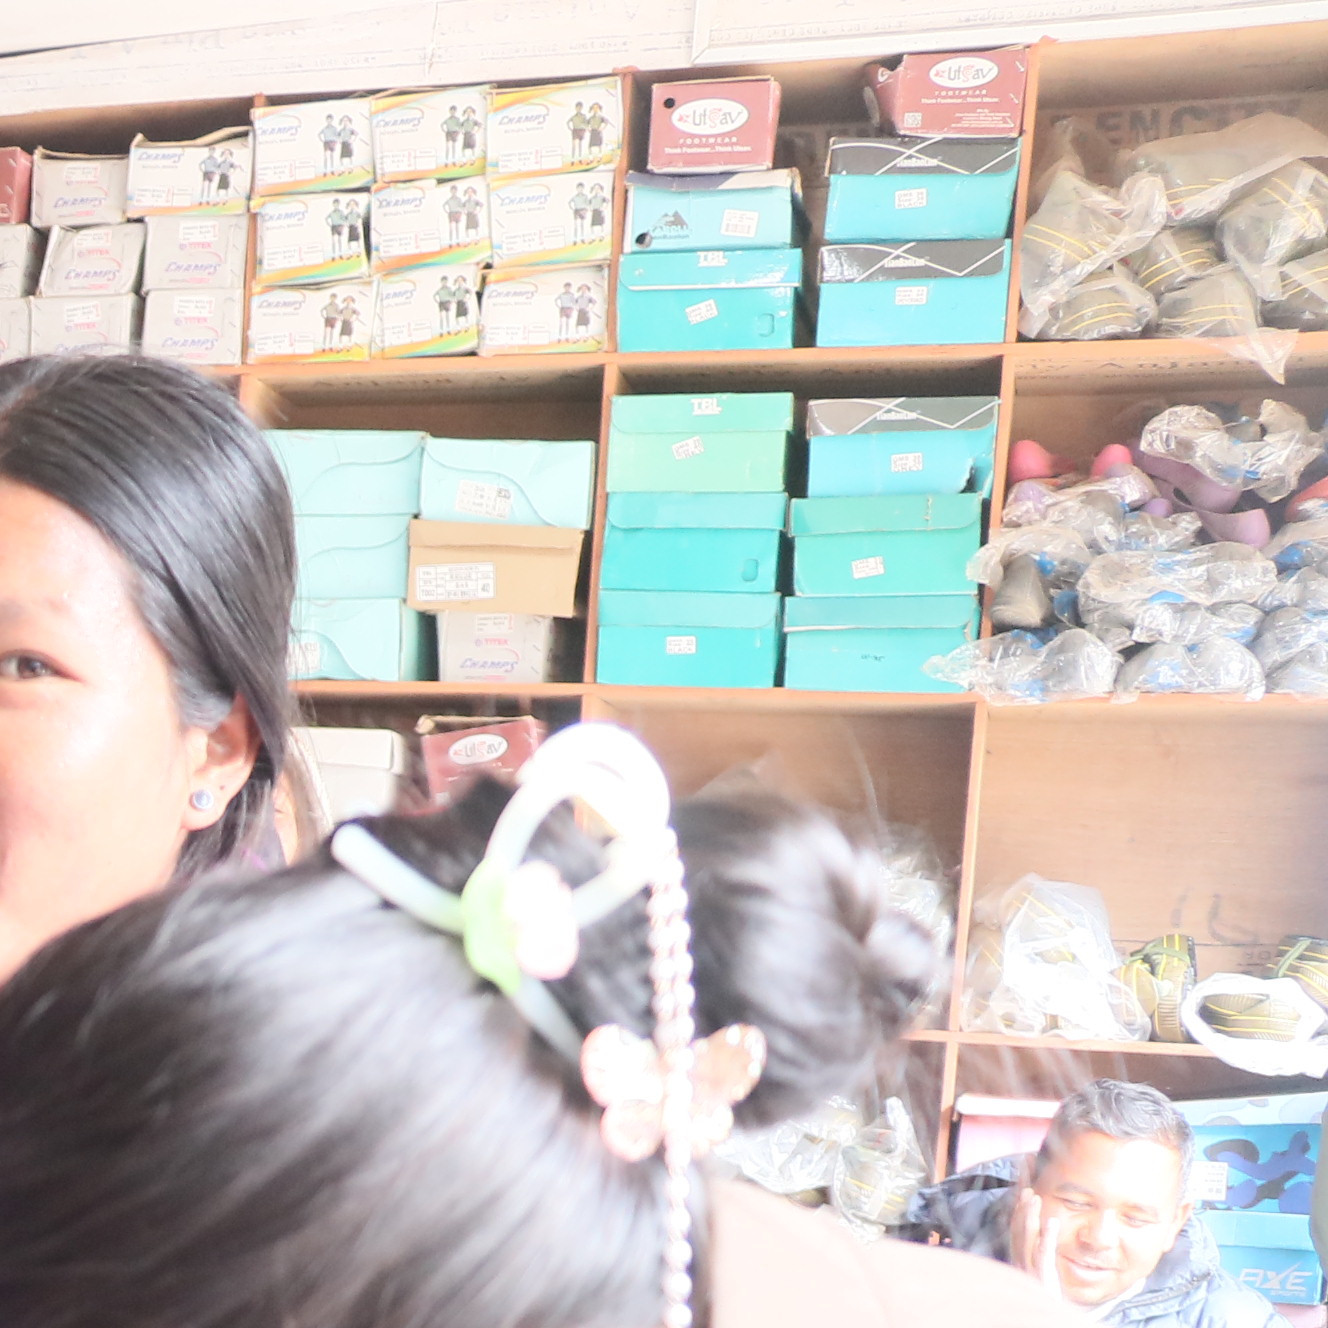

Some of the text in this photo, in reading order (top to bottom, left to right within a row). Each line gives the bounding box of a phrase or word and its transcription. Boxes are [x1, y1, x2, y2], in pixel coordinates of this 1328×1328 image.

[376, 116, 424, 128] CHAMPS
[498, 113, 550, 126] CHAMPS
[137, 150, 185, 162] CHAMPS
[53, 197, 107, 208] CHAMPS
[378, 196, 425, 208] CHAMPS
[500, 194, 550, 206] CHAMPS
[262, 210, 309, 222] CHAMPS
[165, 262, 221, 274] CHAMPS
[65, 268, 121, 281] CHAMPS
[488, 288, 539, 300] CHAMPS
[258, 298, 306, 310] CHAMPS
[161, 337, 218, 350] CHAMPS
[460, 658, 519, 672] CHAMPS
[1239, 1262, 1314, 1291] AXE
